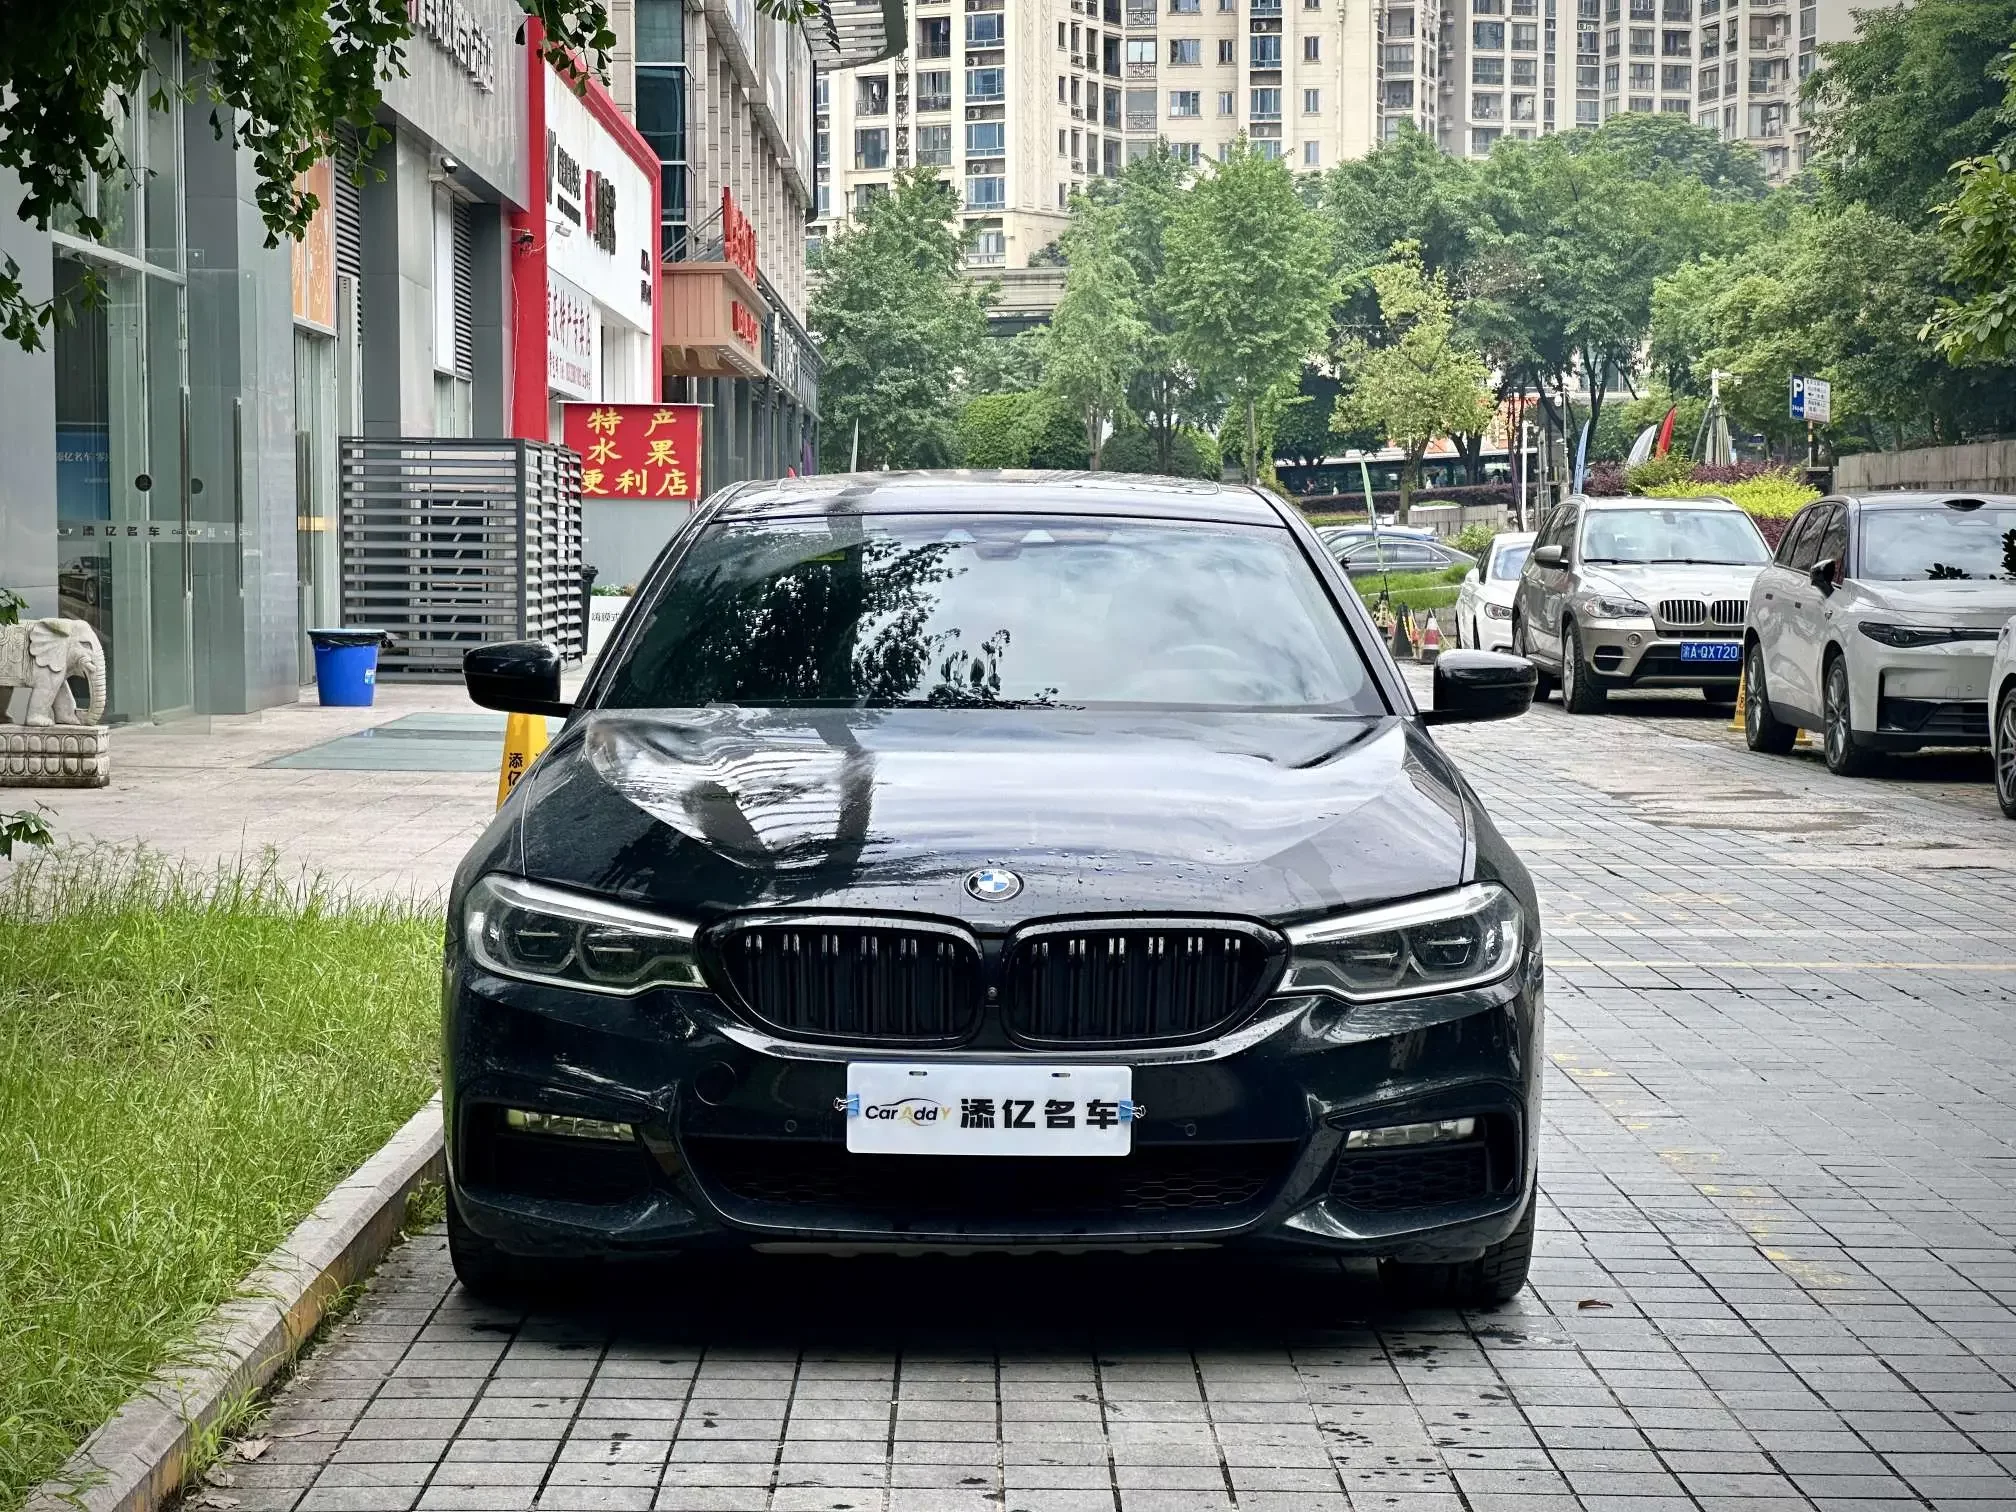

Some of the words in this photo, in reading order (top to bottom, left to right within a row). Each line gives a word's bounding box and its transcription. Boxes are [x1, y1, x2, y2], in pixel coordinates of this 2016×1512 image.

[1794, 378, 1803, 398] P
[587, 406, 677, 437] 特产
[587, 437, 680, 467] 水果
[508, 752, 523, 795] 添亿
[960, 1098, 1119, 1129] 添亿名车
